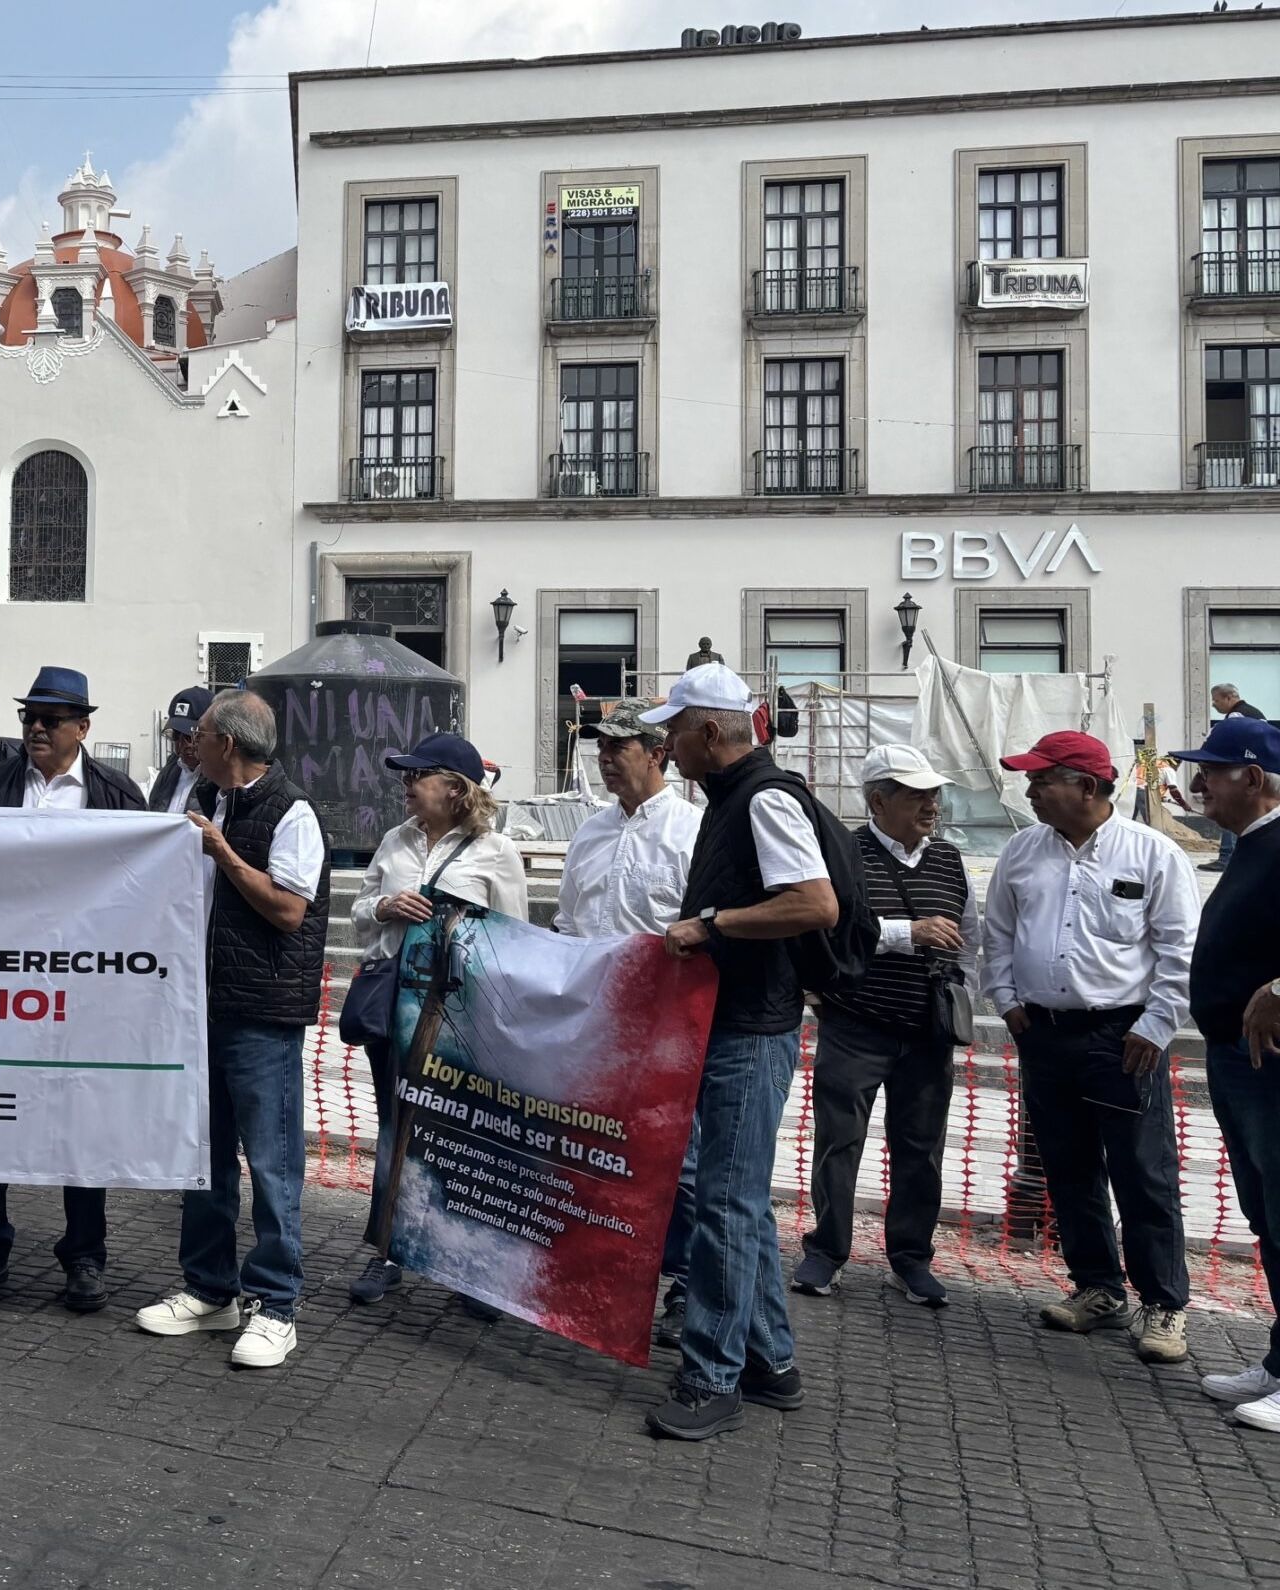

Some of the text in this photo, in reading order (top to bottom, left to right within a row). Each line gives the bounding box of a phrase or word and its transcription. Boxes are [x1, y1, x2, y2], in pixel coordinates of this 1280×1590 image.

[567, 188, 613, 199] VISAS &
[567, 194, 634, 208] MIGRACIÓN
[592, 207, 608, 217] 501
[351, 286, 451, 320] TRIBUNA
[986, 266, 1084, 296] TRIBUNA
[901, 522, 1104, 580] BBVA
[285, 687, 337, 746] NI
[347, 686, 436, 750] UNA
[422, 1053, 628, 1141] Hoy son las pensiones.
[394, 1075, 634, 1178] Mañana puede ser tu casa.
[413, 1123, 576, 1197] Y si aceptamos este precedente,
[424, 1147, 636, 1239] lo que se abre no es solo un debate jurídico,
[445, 1178, 565, 1234] sino la puerta al despojo
[446, 1199, 553, 1248] patrimonial en México.
